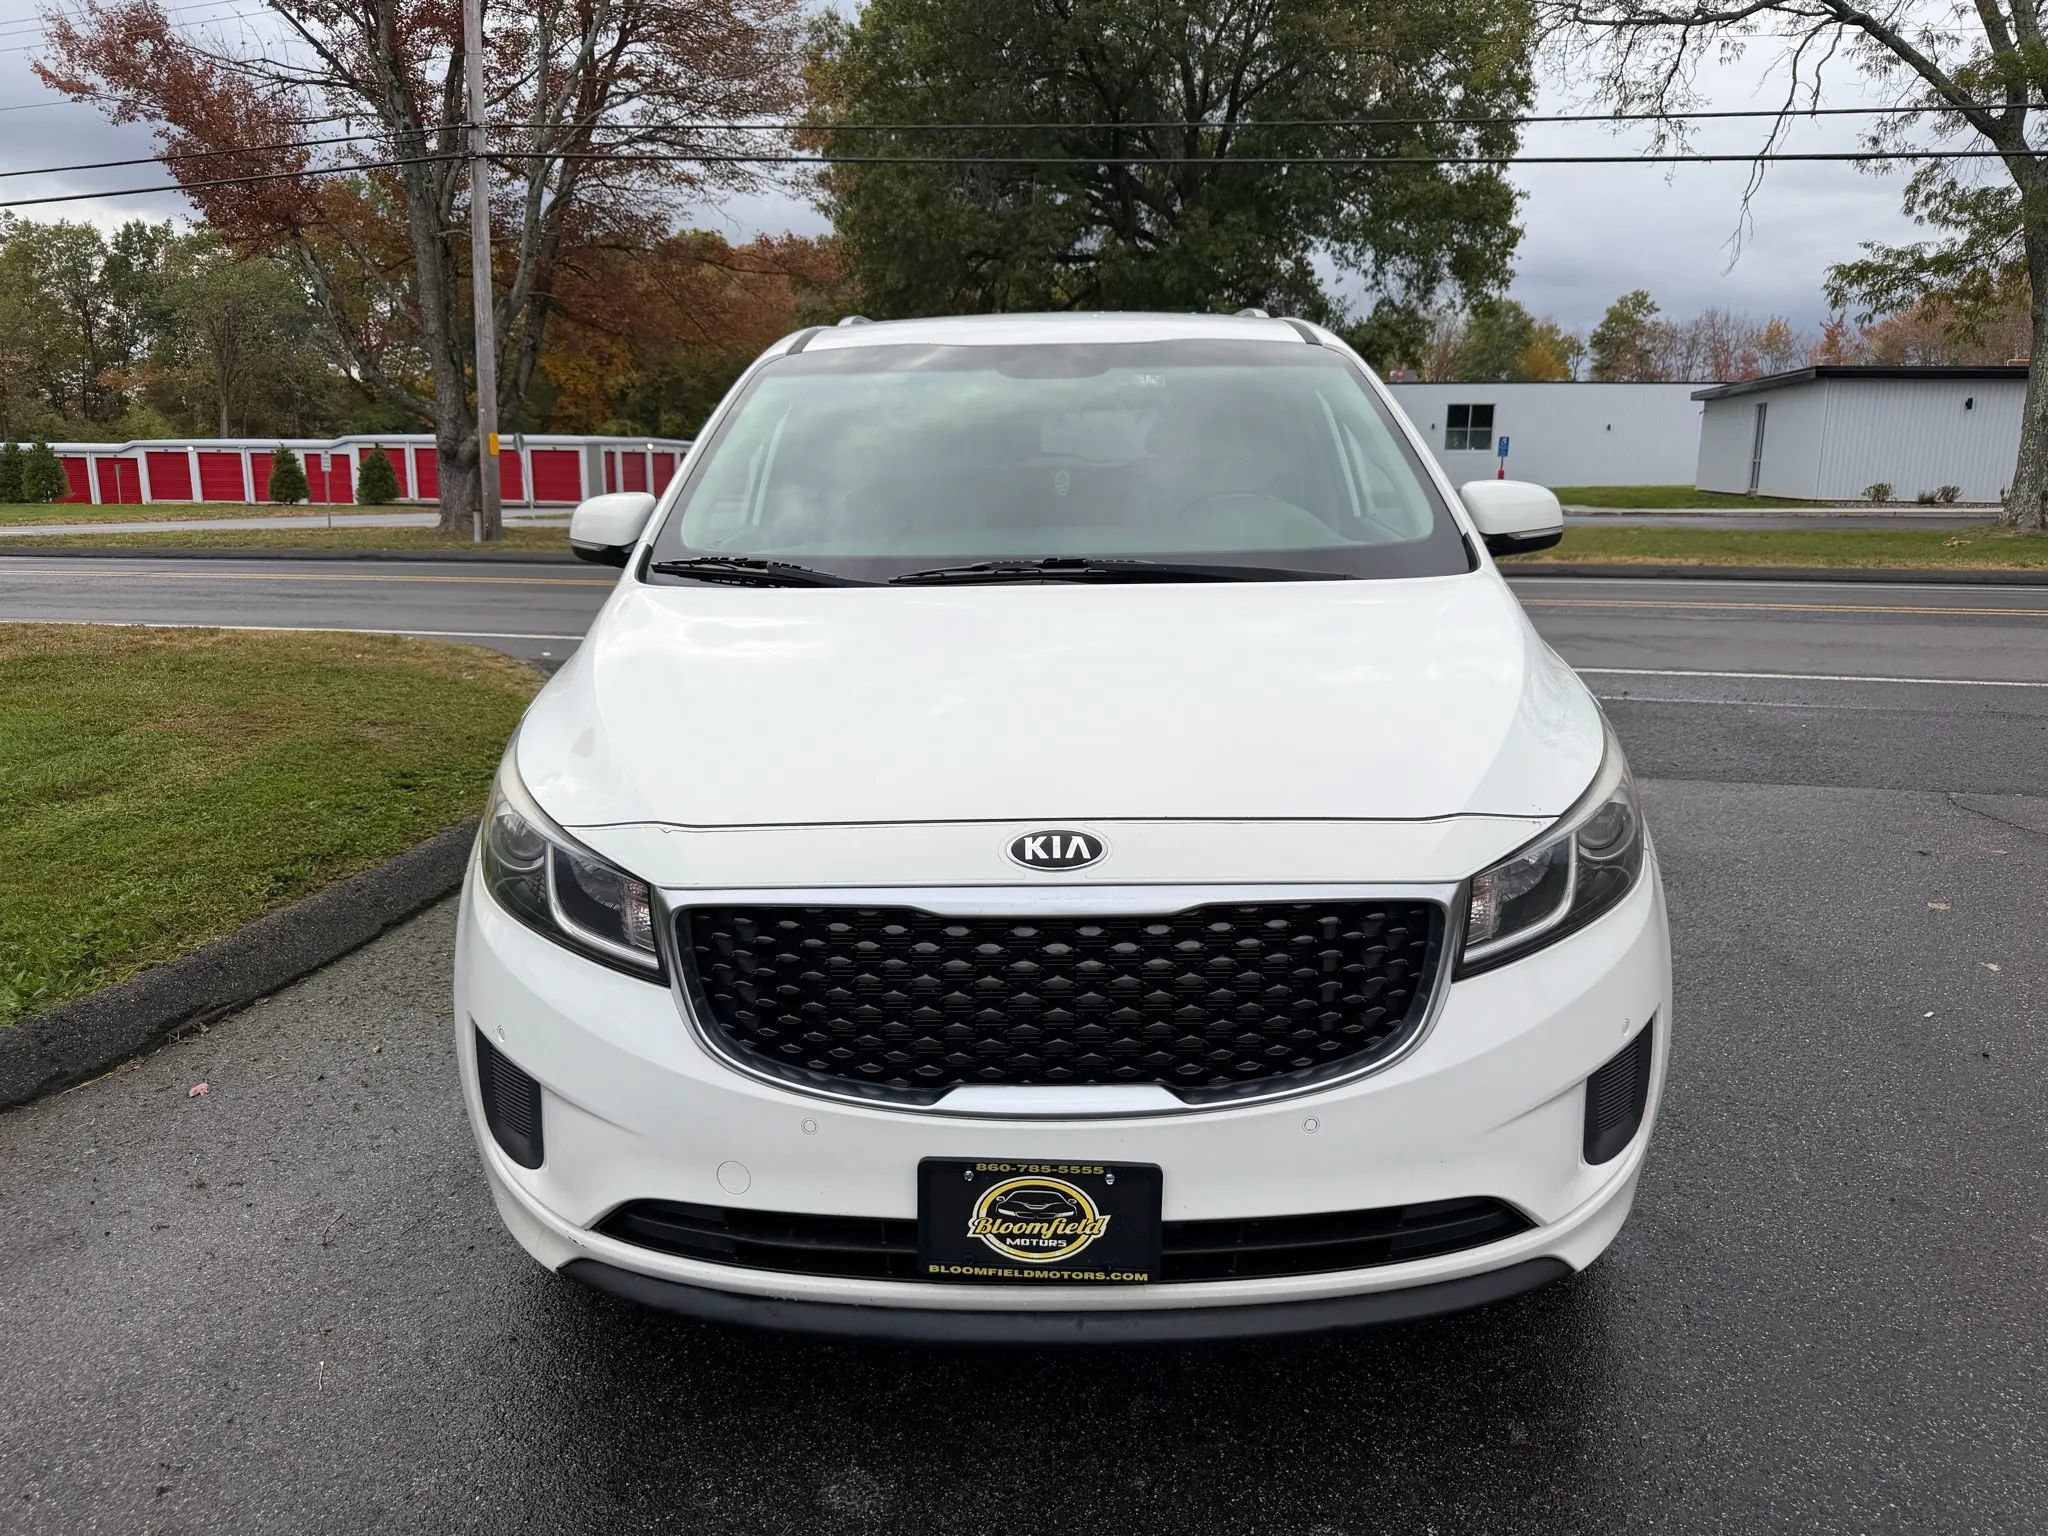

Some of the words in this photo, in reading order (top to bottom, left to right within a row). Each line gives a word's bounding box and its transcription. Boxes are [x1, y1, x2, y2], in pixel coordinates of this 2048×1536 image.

[1023, 835, 1091, 860] KIA
[975, 1163, 1105, 1175] 860-785-5555
[973, 1217, 1104, 1239] Bloomfield
[1006, 1238, 1067, 1247] MOTORS
[928, 1264, 1149, 1281] BLOOMFIELDMOTORS.COM
